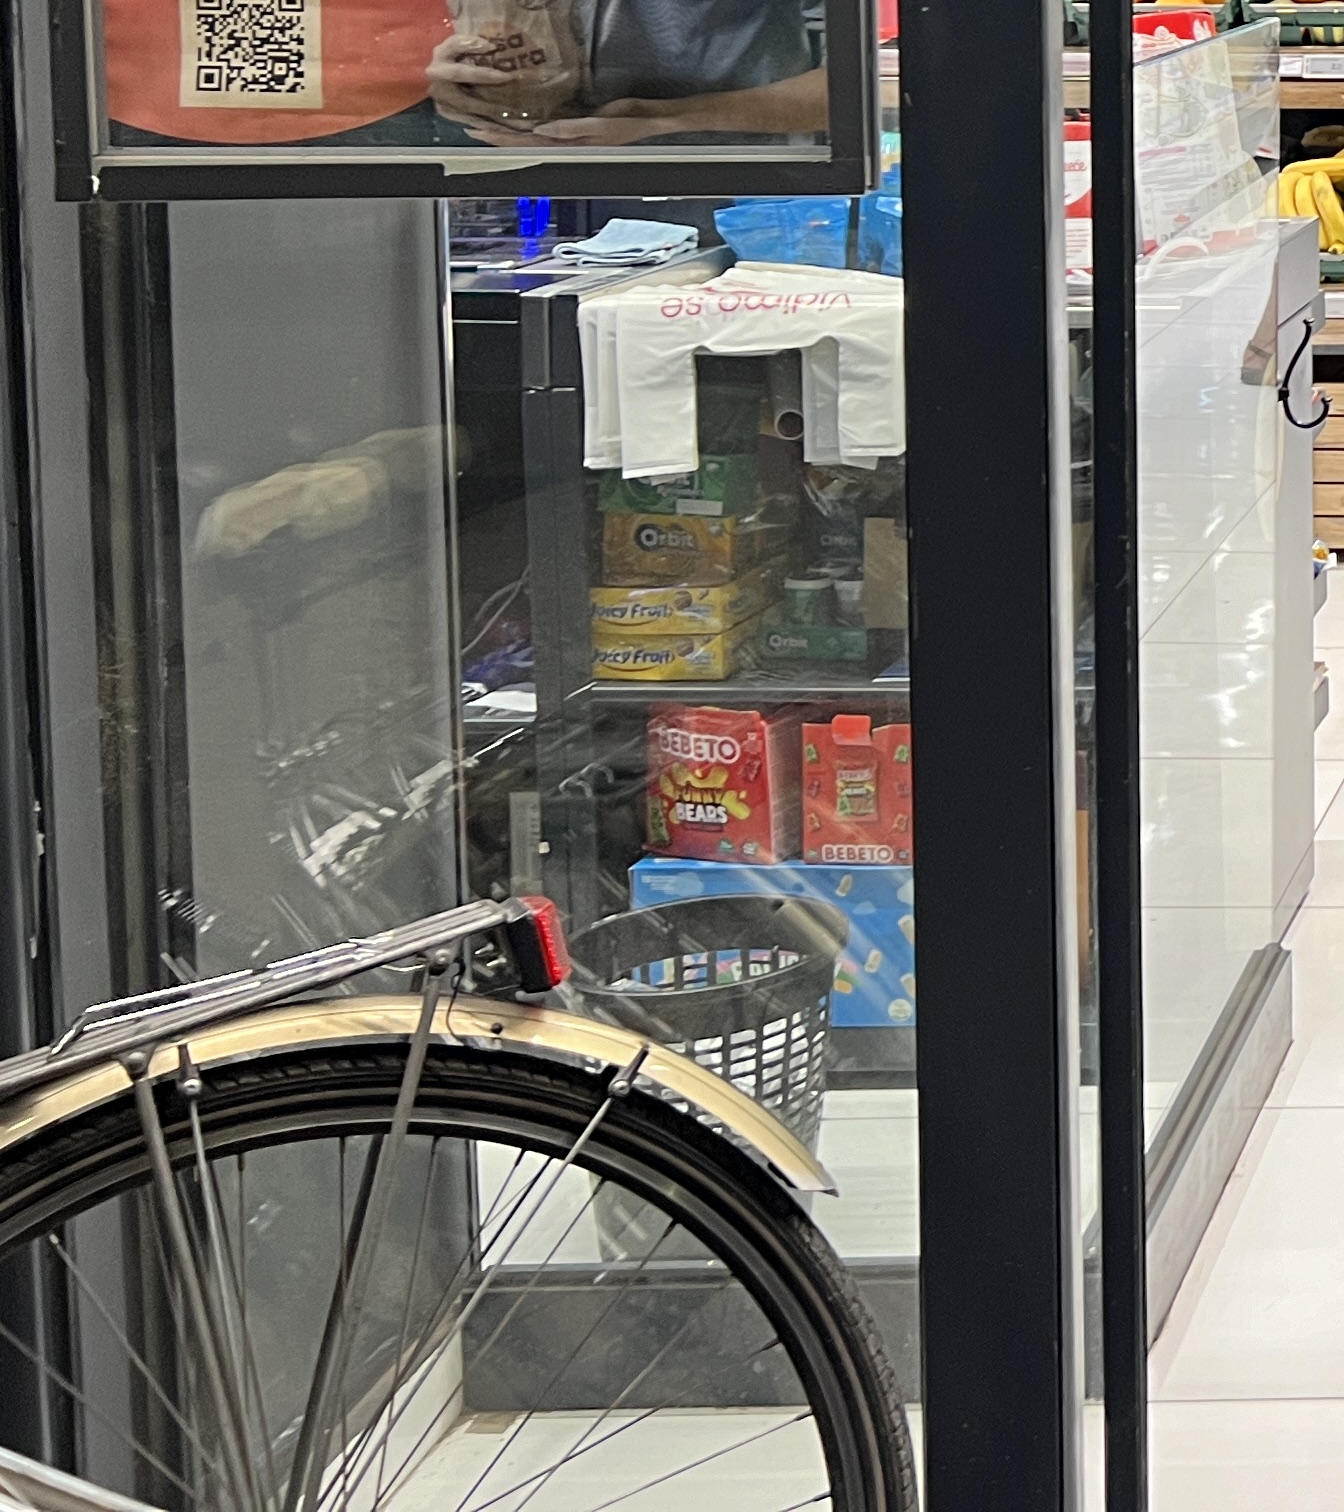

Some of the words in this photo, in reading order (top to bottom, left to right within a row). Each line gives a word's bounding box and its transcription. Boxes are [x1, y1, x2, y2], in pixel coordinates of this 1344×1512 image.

[639, 528, 695, 548] Orbit
[658, 728, 740, 764] BEBETO
[676, 800, 728, 824] BEARS
[822, 844, 895, 863] BEBETO
